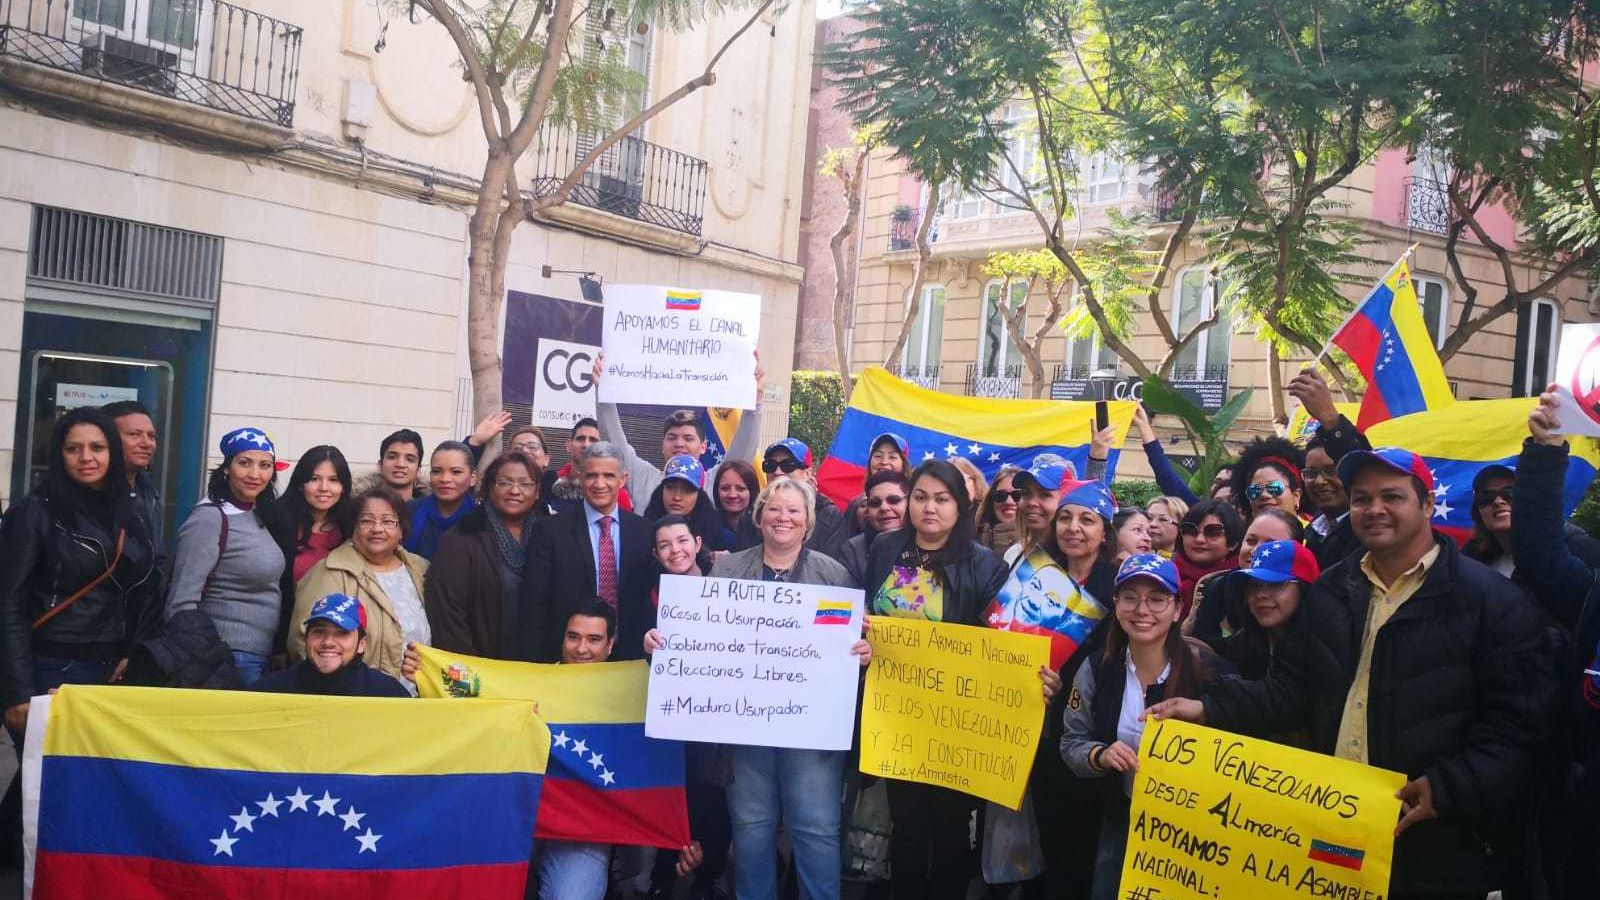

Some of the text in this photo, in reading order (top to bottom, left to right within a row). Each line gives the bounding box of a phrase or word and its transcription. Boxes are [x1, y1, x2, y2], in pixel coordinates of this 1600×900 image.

[614, 310, 748, 337] APOYAMOS EL CANAL
[543, 348, 594, 394] CG
[701, 579, 802, 605] LA RUTA ES:
[707, 606, 721, 623] la
[728, 638, 745, 653] de
[872, 621, 921, 648] FUERZA
[928, 627, 972, 657] ARMADA
[667, 658, 744, 679] Elecciones
[753, 664, 807, 683] Libres.
[875, 656, 1023, 708] PONGANSE DEL LADO
[660, 696, 731, 716] #Maduro
[874, 693, 1030, 748] DE LOS VENEZOLANOS
[870, 730, 881, 749] Y
[892, 734, 912, 754] LA
[1148, 723, 1361, 819] LOS VENEZOLANOS
[1143, 777, 1200, 810] DESDE
[1134, 810, 1384, 900] APOYAMOS A LA ASAMBLE
